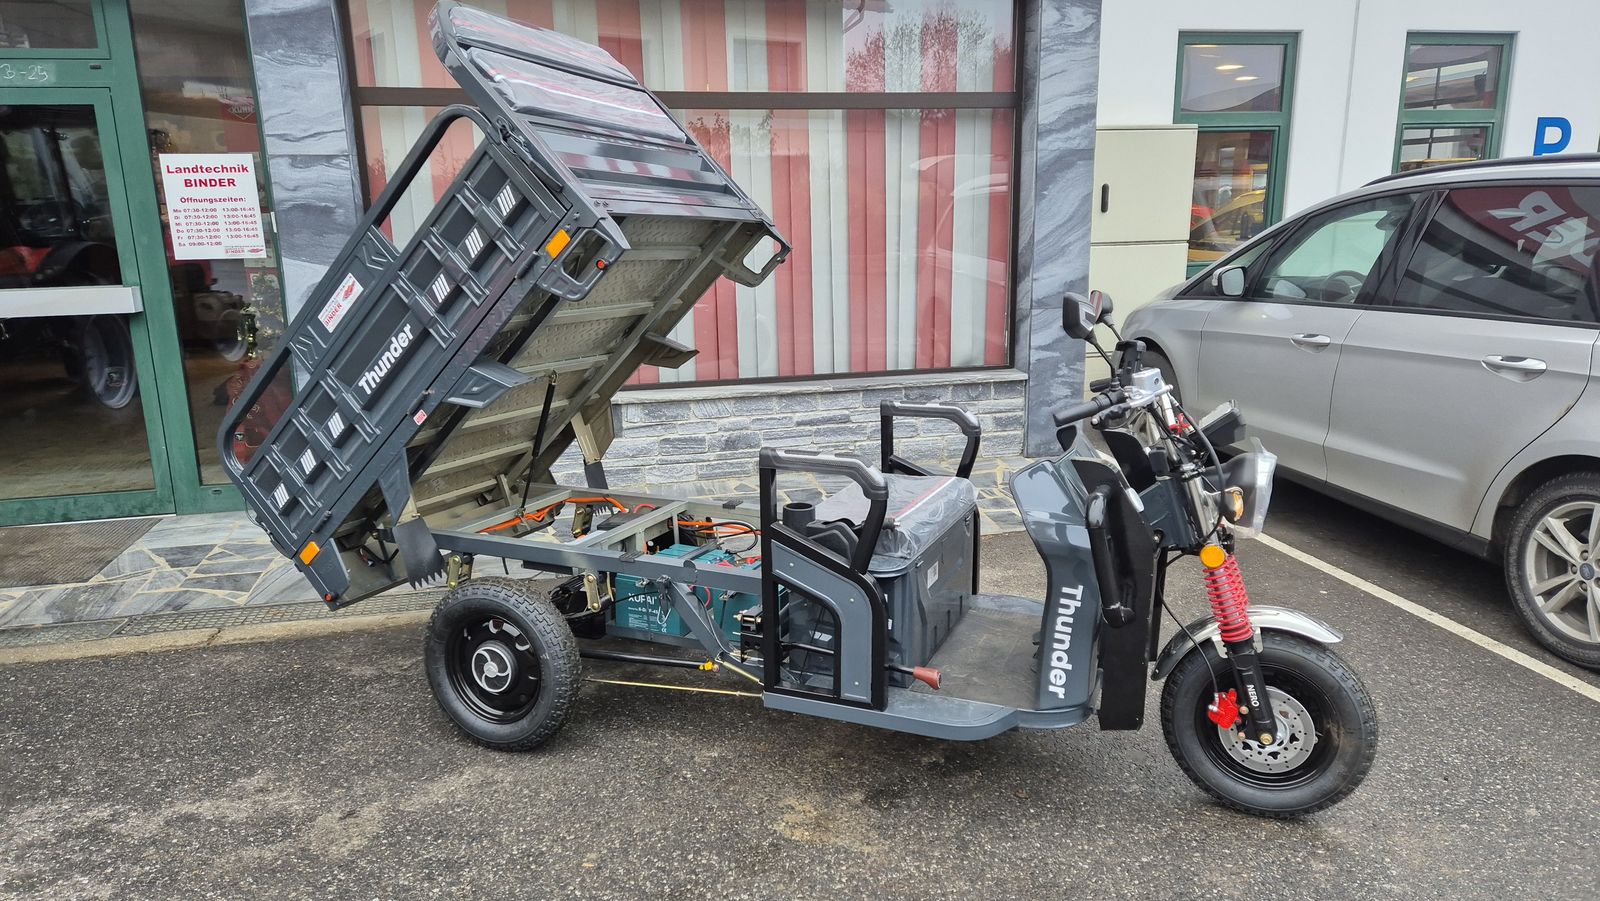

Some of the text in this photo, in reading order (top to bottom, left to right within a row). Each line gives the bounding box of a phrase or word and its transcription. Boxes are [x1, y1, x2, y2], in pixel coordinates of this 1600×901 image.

[1533, 116, 1572, 156] P
[166, 164, 249, 174] Landtechnik
[184, 178, 237, 188] BINDER
[358, 323, 414, 395] Thunder
[1048, 585, 1083, 700] Thunder
[1246, 684, 1260, 707] NERO
